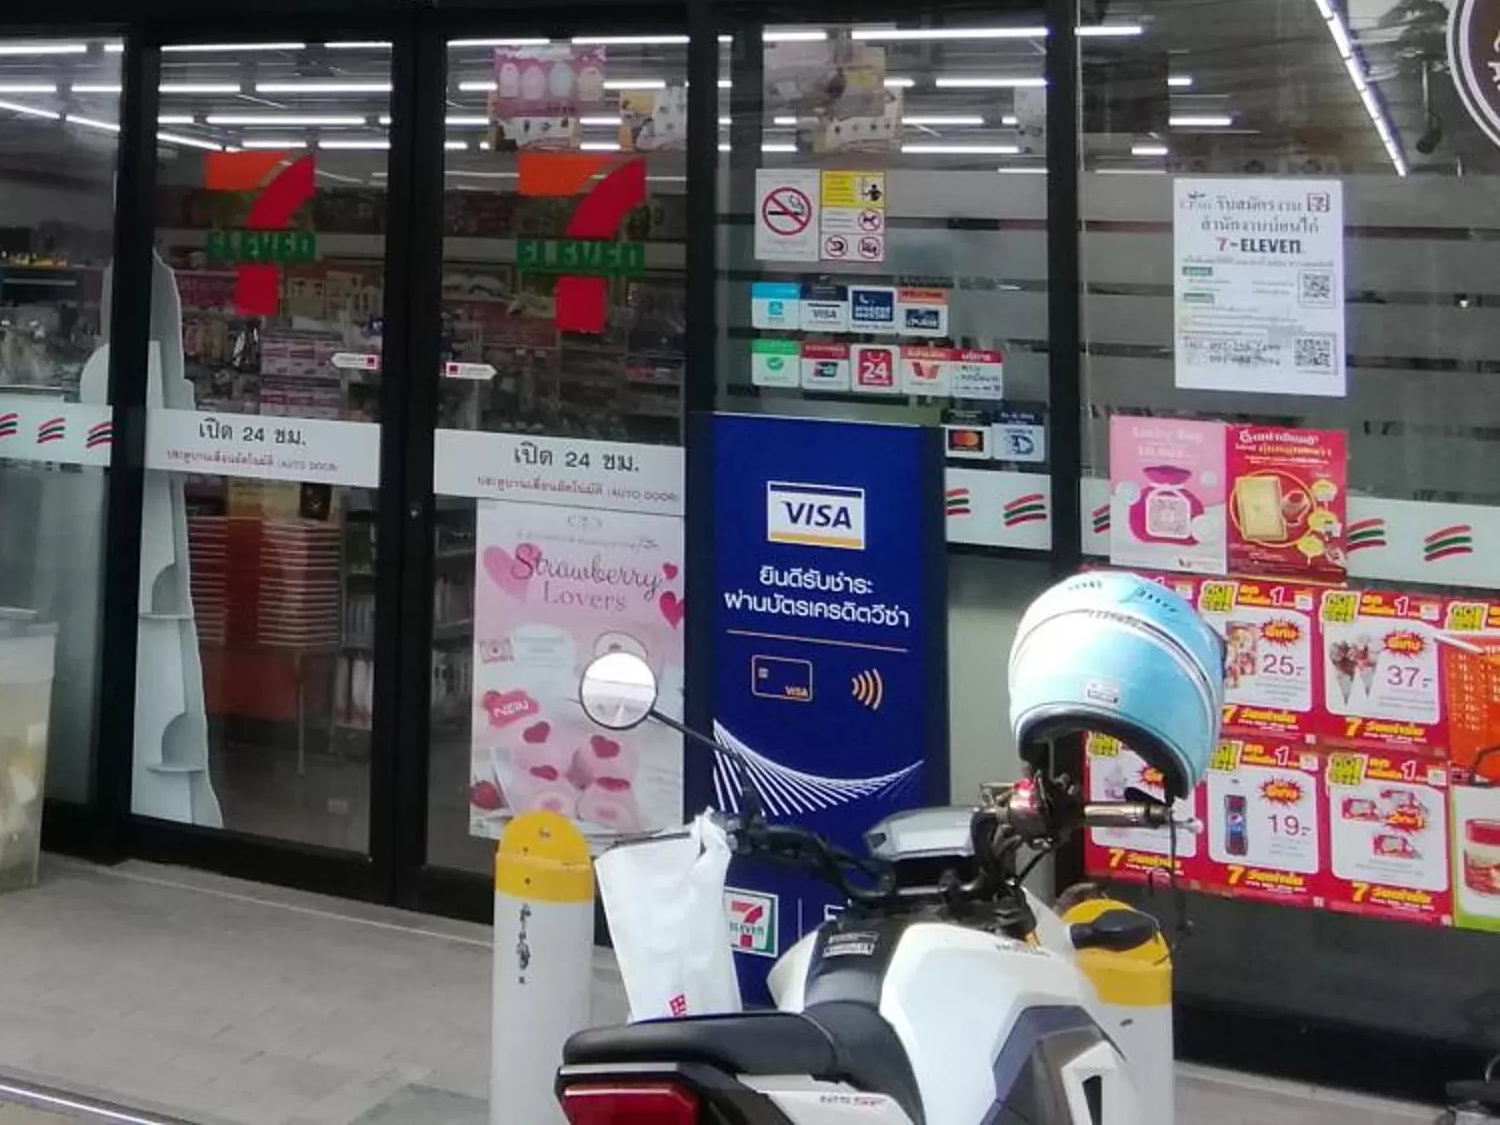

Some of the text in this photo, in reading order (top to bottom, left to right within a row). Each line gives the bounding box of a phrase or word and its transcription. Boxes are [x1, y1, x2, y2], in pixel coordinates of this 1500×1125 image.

[1216, 236, 1301, 254] 7-ELEVEN
[862, 362, 889, 379] 24
[198, 418, 307, 446] เปิด 24 ชม.
[514, 441, 640, 473] เปิด 24 ชม.
[781, 500, 852, 530] VISA
[510, 542, 663, 603] Strawberry
[759, 564, 875, 595] ยินดีรับชำระ
[543, 580, 627, 612] Lovers
[724, 588, 910, 628] ผ่านบัตรเครดิตวีซ่า
[785, 685, 810, 698] VISA
[493, 698, 531, 720] NEW
[1108, 848, 1125, 868] 7
[1227, 865, 1245, 885] 7
[1352, 881, 1370, 902] 7
